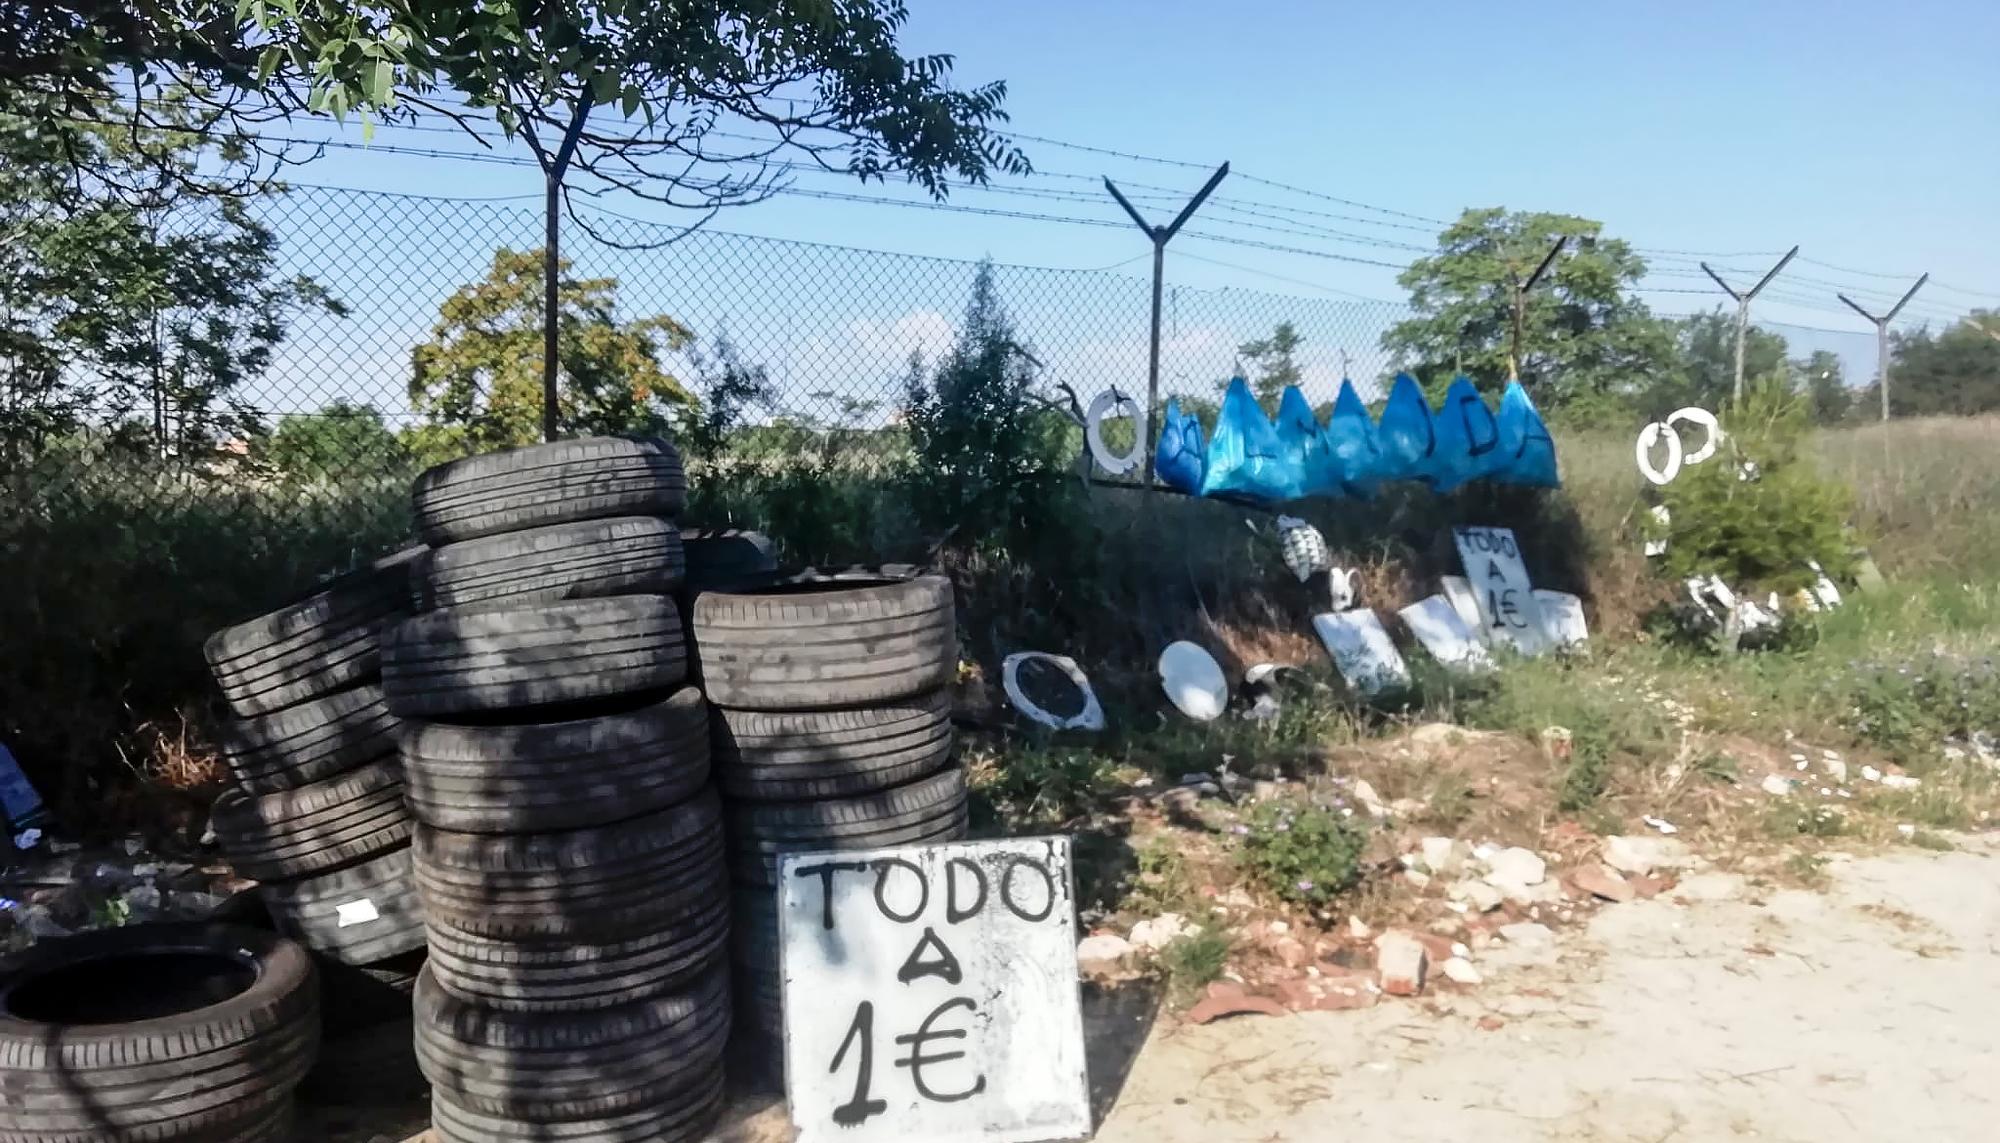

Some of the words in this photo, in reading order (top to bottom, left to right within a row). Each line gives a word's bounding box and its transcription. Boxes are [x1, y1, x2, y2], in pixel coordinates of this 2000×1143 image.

[1458, 530, 1517, 559] TODO
[1487, 558, 1507, 584] A
[794, 856, 1055, 930] TODO
[897, 926, 962, 985] A
